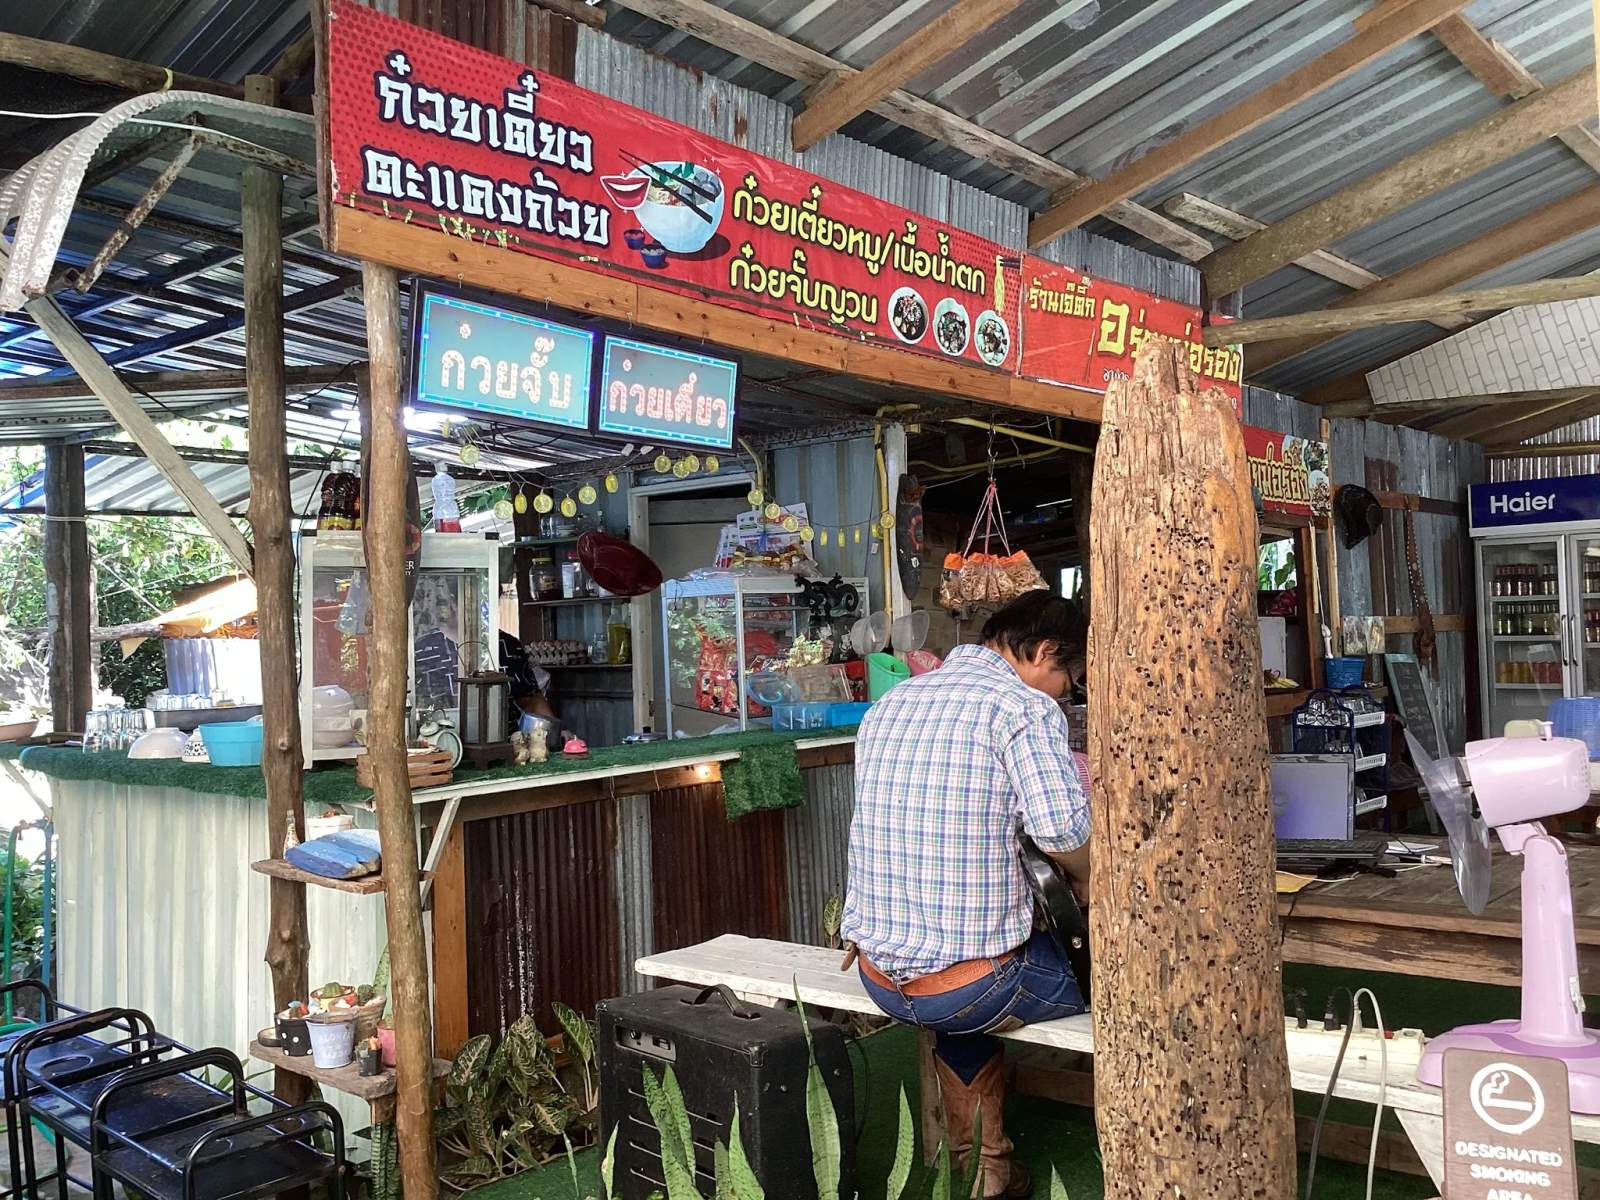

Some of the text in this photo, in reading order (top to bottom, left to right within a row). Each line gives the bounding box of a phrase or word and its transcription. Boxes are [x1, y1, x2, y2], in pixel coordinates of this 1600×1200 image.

[1490, 491, 1556, 514] Haier
[1455, 1141, 1563, 1167] DESIGNATED
[1469, 1163, 1551, 1187] SMOKING
